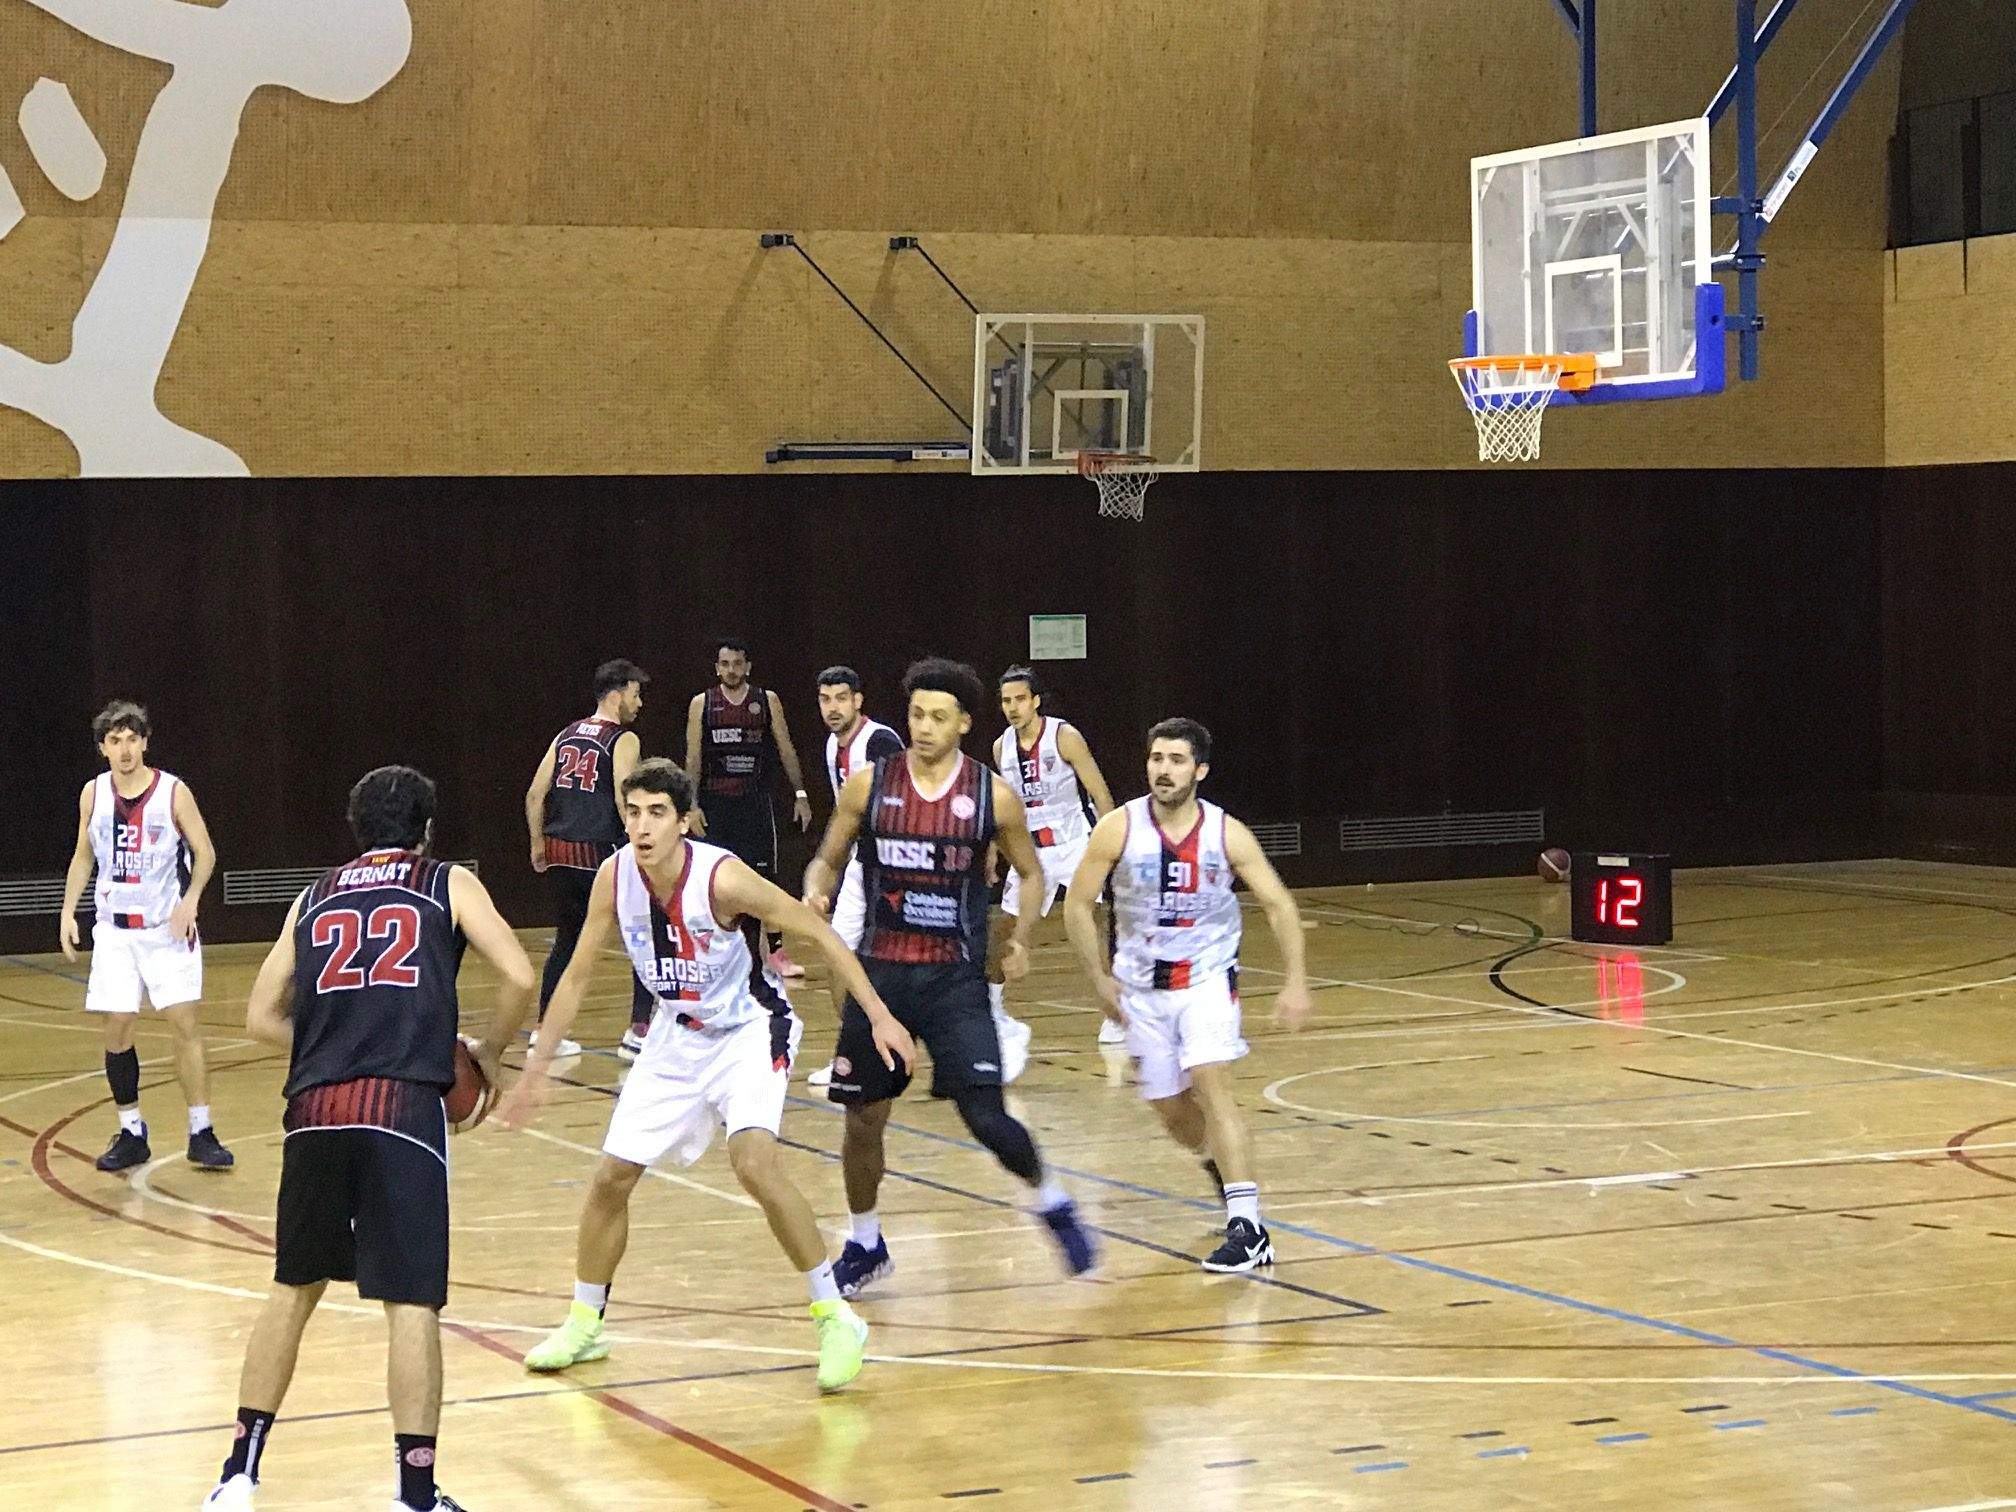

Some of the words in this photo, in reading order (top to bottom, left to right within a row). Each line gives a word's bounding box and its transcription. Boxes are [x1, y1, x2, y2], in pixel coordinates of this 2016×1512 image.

[556, 745, 599, 793] 24
[117, 824, 139, 848] 22
[874, 837, 937, 870] UESC
[337, 863, 411, 886] BERNAT
[1167, 861, 1192, 888] 91
[1599, 879, 1642, 926] 12
[312, 903, 421, 995] 22
[666, 924, 684, 953] 4
